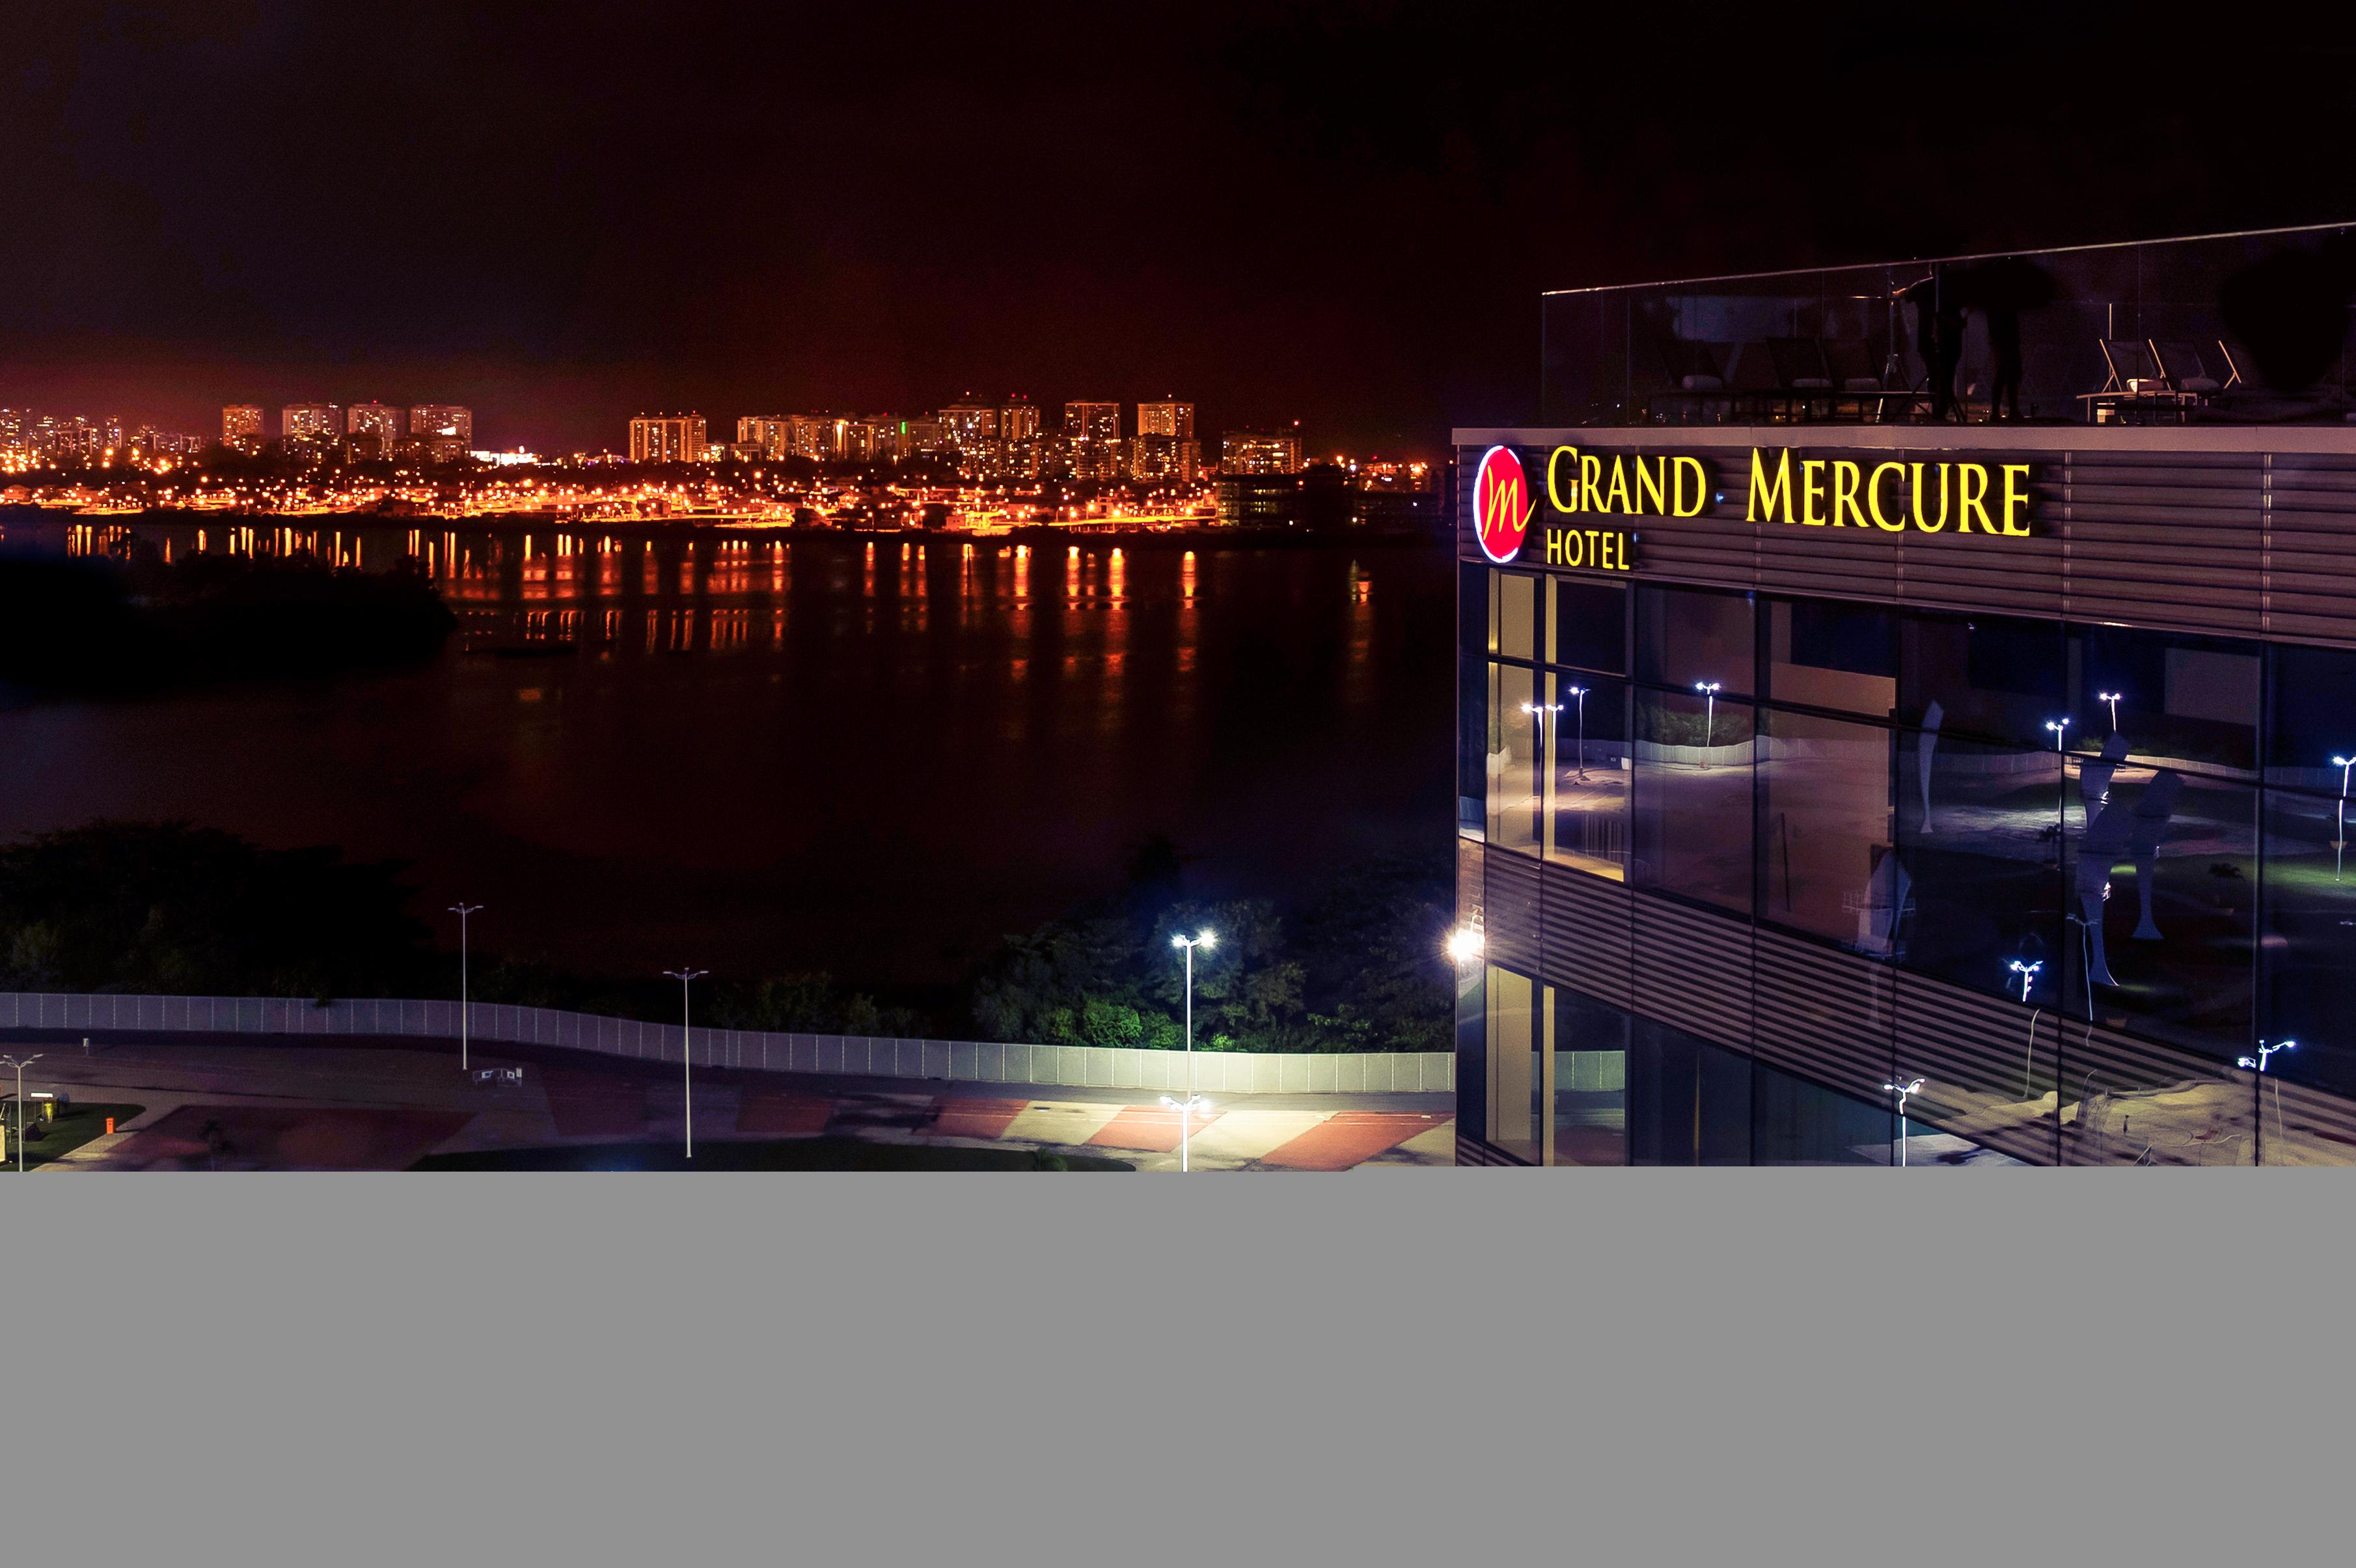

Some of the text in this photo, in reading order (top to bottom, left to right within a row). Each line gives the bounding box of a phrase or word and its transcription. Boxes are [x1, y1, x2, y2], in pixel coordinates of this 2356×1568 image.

[1546, 445, 2031, 537] GRAND MERCURE
[1546, 528, 1630, 571] HOTEL
